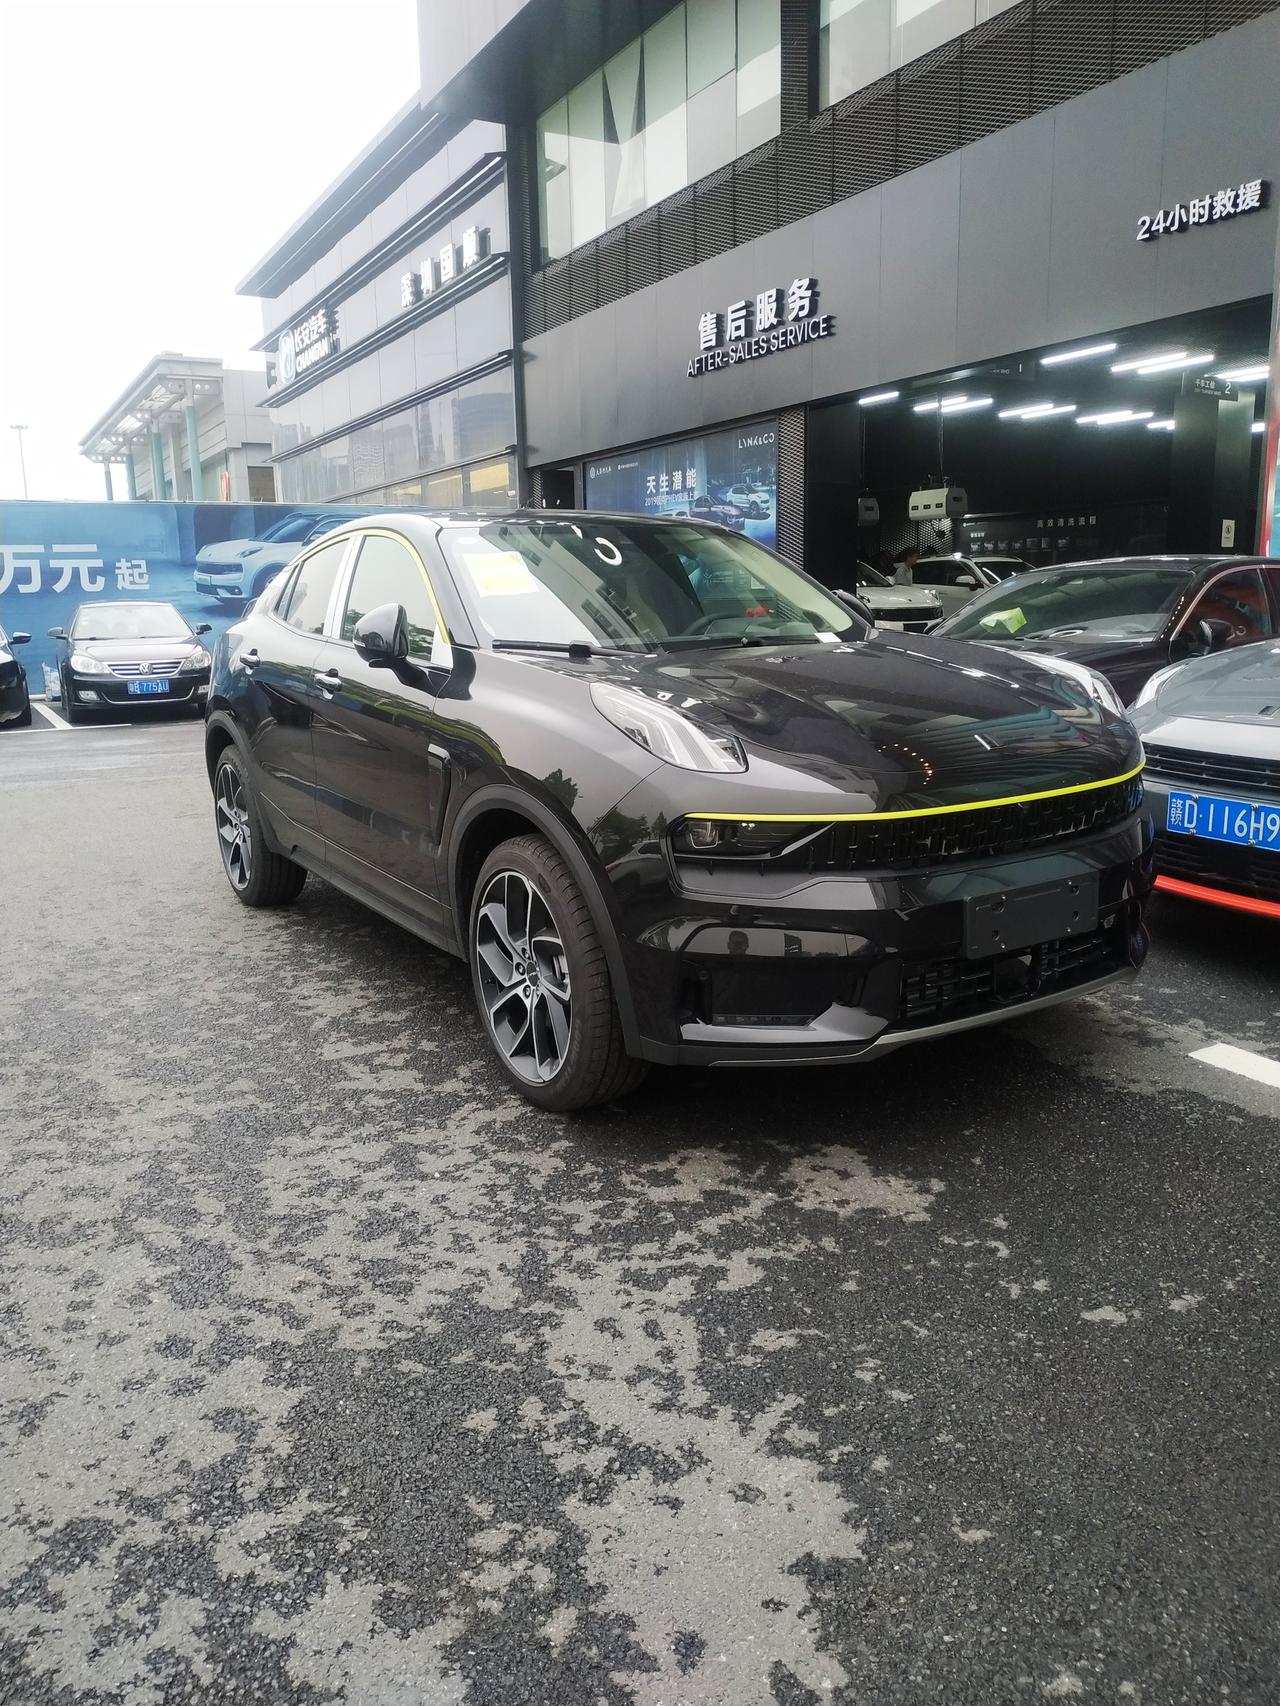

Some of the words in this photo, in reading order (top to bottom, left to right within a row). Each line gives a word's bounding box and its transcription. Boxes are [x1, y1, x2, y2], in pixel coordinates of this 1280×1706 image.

[1136, 179, 1262, 240] 24小时救援
[294, 309, 327, 353] 长安汽车
[698, 278, 812, 350] 售后服务
[296, 336, 329, 373] CHANGAN
[686, 335, 767, 377] AFTER-SALES
[770, 314, 829, 351] SERVICE
[1224, 382, 1232, 394] 2
[646, 467, 697, 495] 天生潜能
